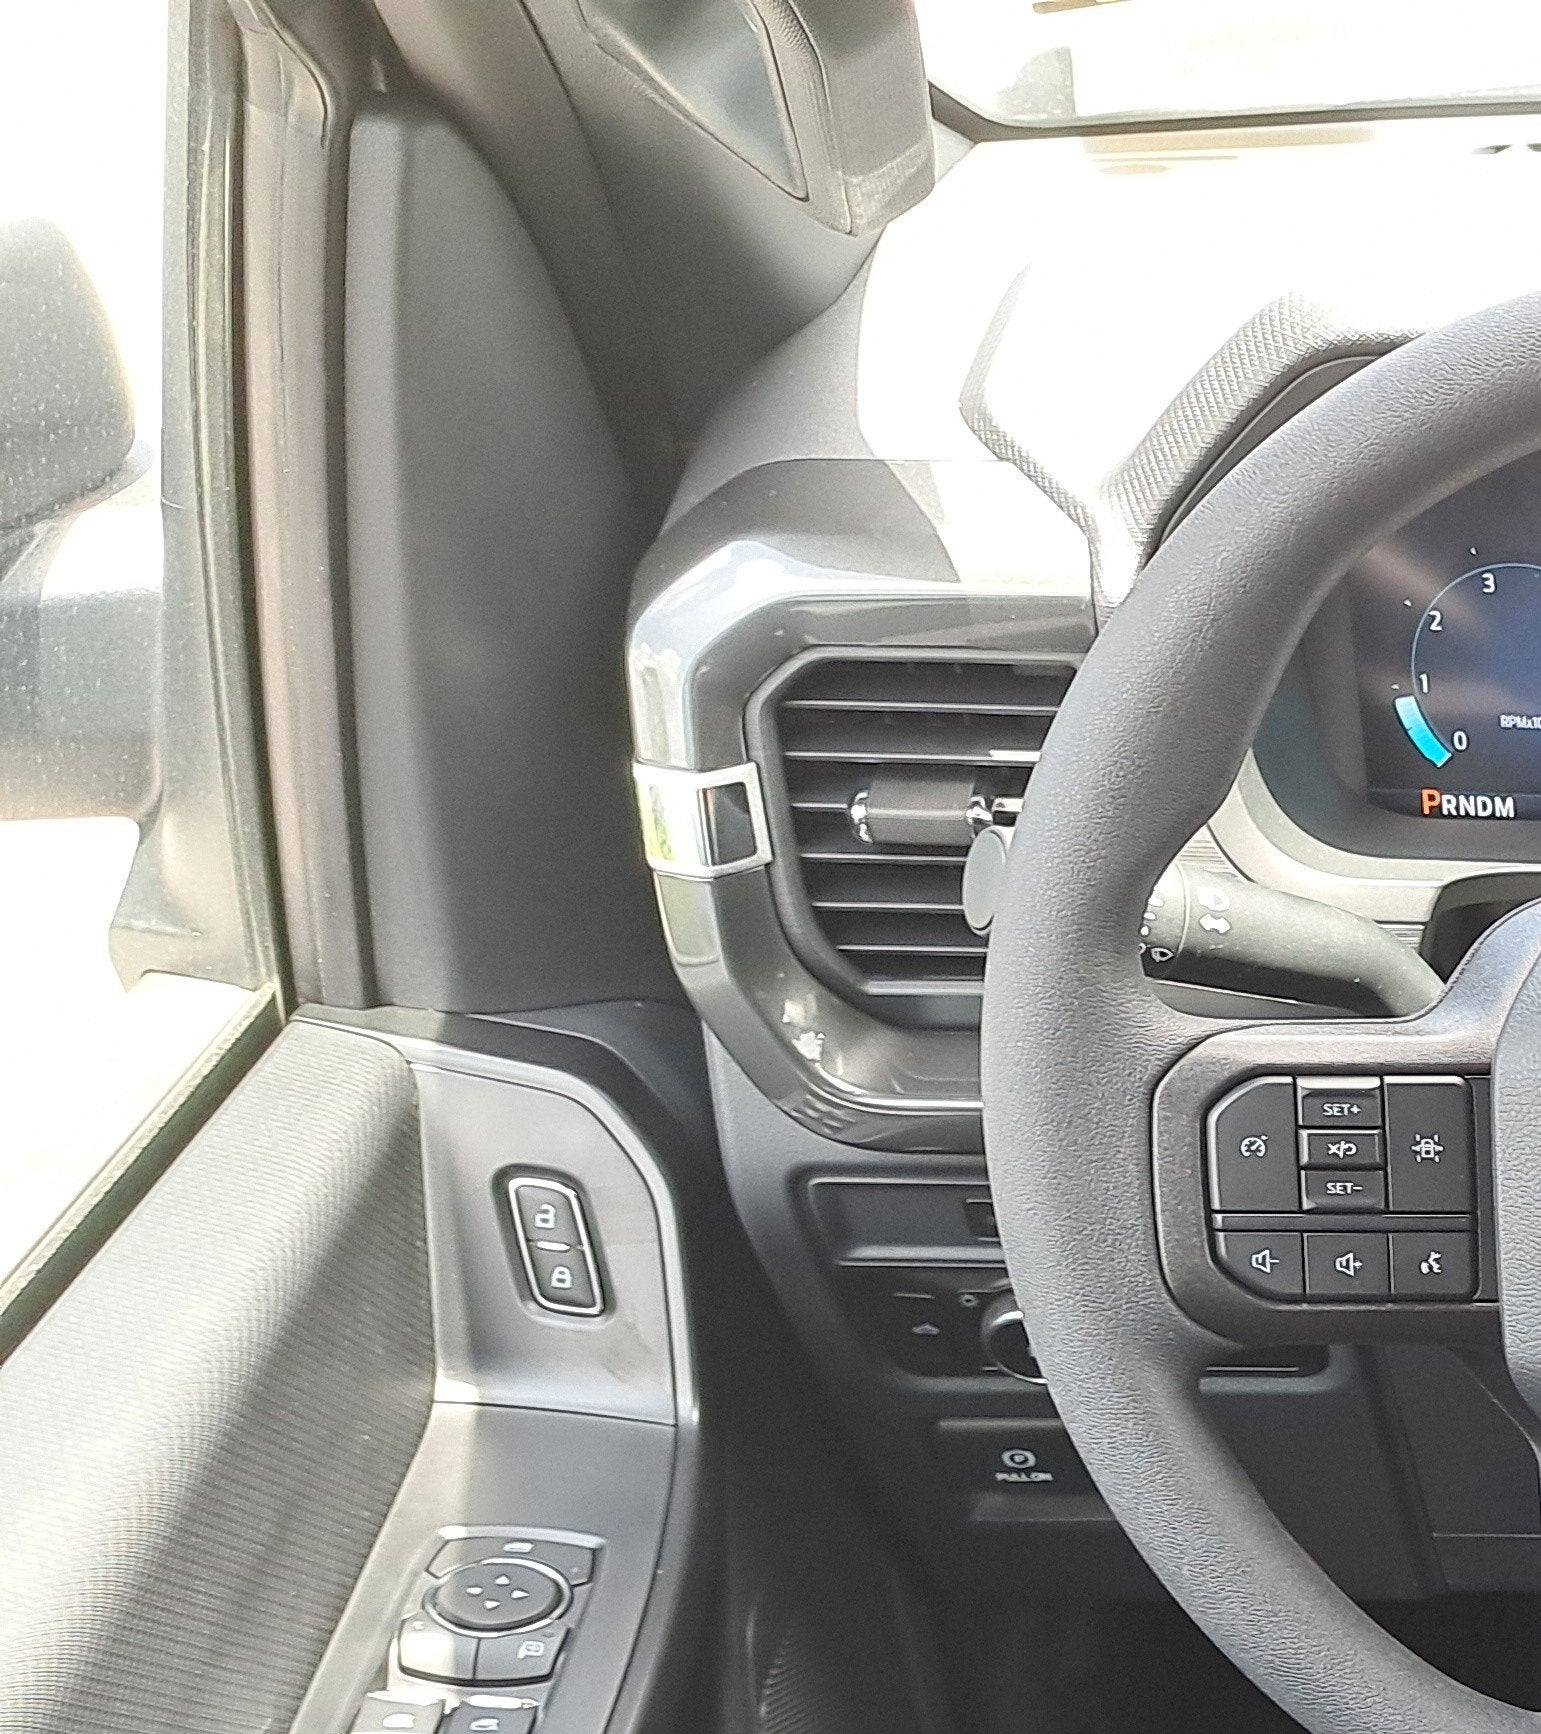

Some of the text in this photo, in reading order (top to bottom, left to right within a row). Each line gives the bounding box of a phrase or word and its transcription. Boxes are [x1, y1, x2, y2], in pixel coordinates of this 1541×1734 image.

[1482, 574, 1496, 593] 3
[1428, 611, 1443, 631] 2
[1419, 674, 1429, 693] 1
[1453, 731, 1468, 751] 0
